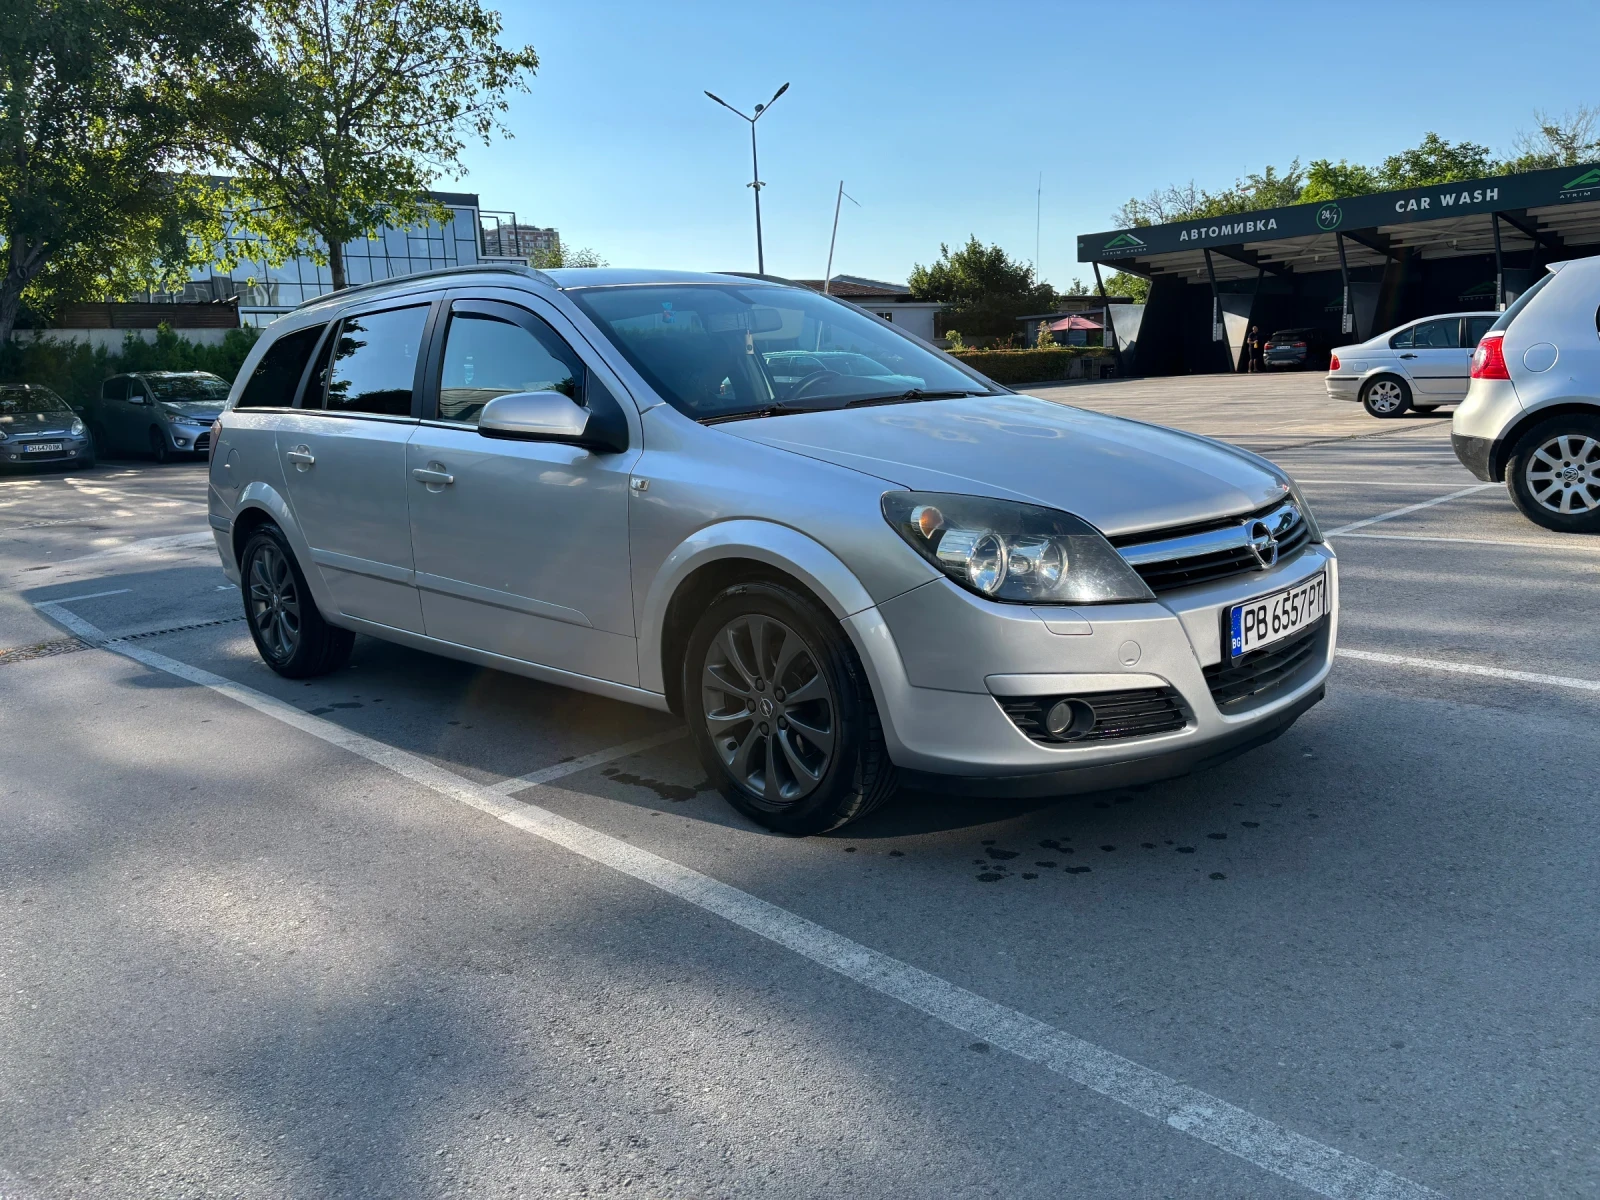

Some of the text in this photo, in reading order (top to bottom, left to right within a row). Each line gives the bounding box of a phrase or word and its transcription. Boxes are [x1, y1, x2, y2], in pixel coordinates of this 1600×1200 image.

[1395, 187, 1498, 212] CAR WASH
[1560, 191, 1590, 199] ATRIM
[1321, 208, 1338, 225] 24/7
[1179, 218, 1278, 242] АВТОМИВКА
[1244, 579, 1323, 646] PB 6557 PT
[1232, 636, 1241, 649] BG
